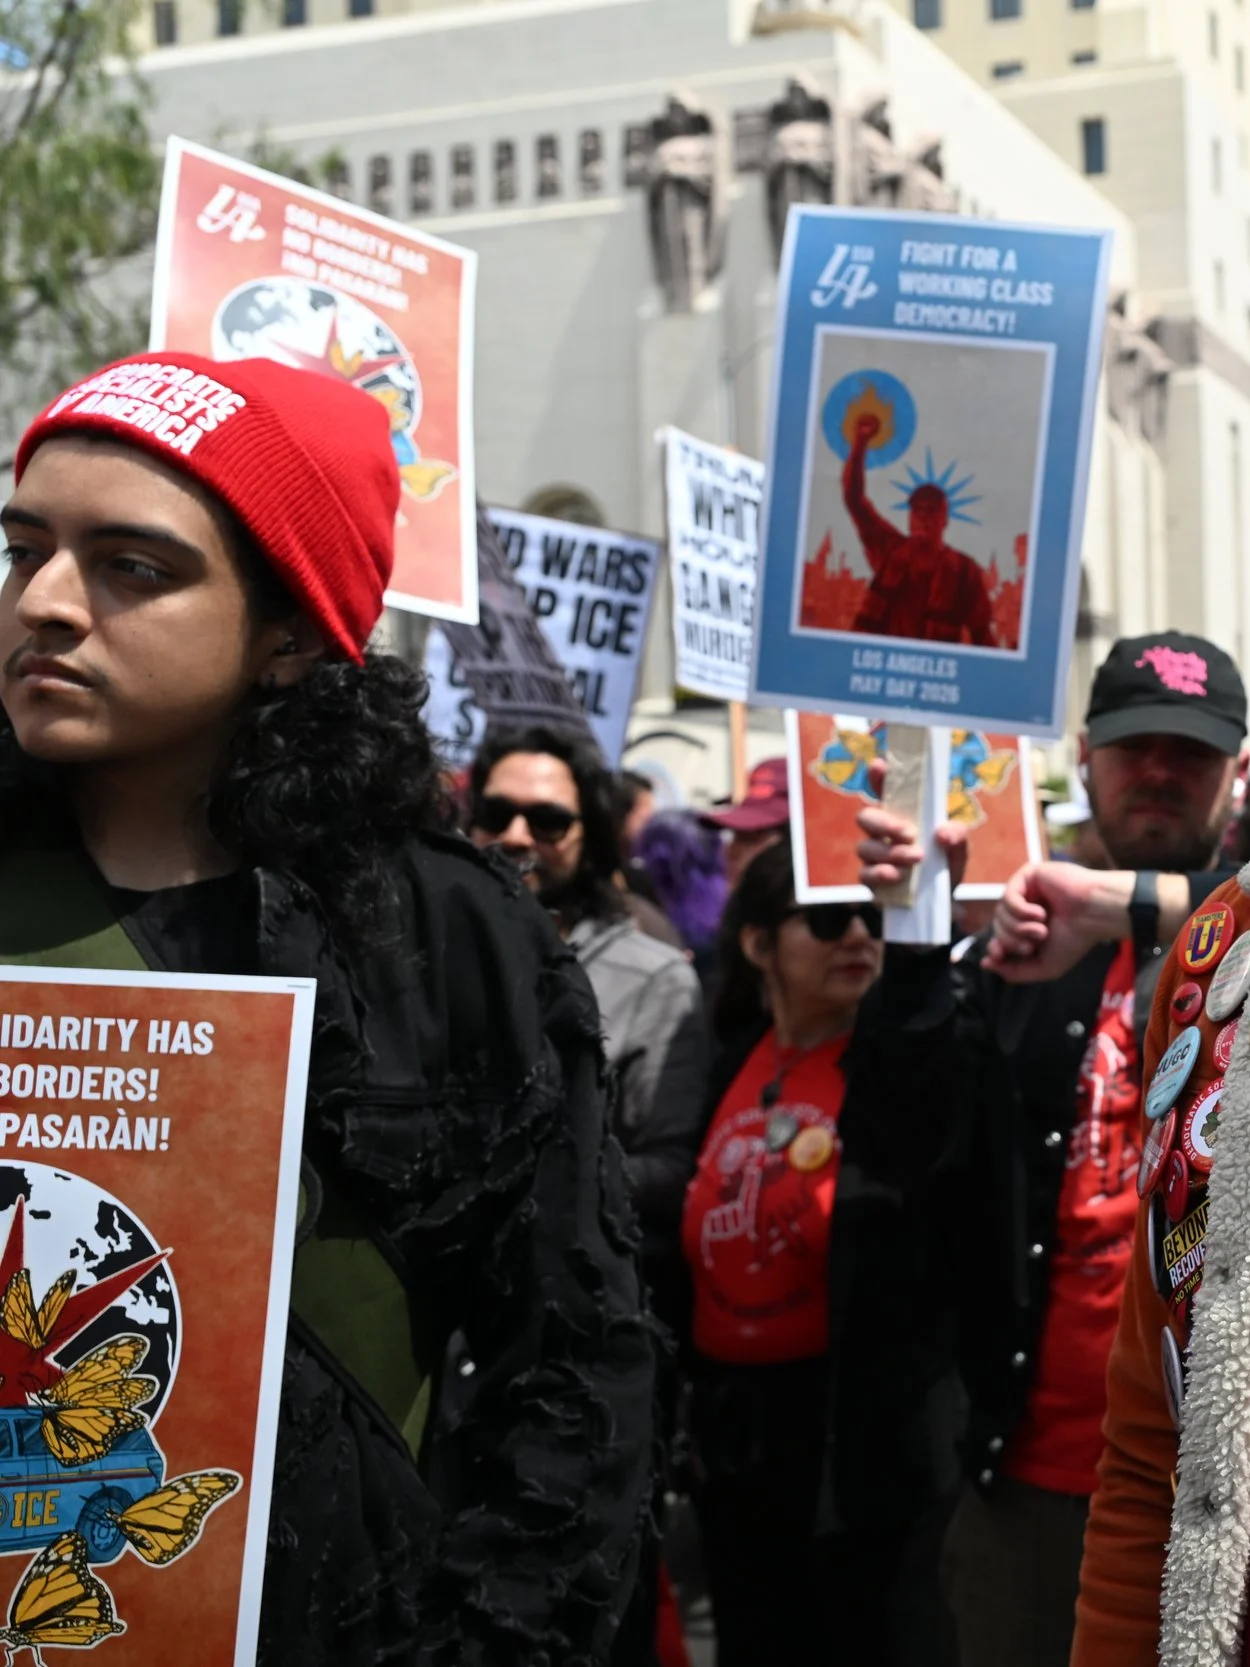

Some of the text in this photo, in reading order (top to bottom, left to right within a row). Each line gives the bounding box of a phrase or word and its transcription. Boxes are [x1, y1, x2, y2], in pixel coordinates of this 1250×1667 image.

[901, 240, 1018, 272] FIGHT FOR A
[898, 270, 1054, 306] WORKING CLASS
[894, 301, 1016, 334] DEMOCRACY!
[72, 392, 203, 455] AMERICA
[542, 532, 650, 595] WARS
[568, 595, 641, 657] ICE
[852, 648, 958, 679] LOS ANGELES
[849, 674, 960, 704] MAY DAY 2026
[0, 1013, 215, 1056] IDARITY HAS
[1156, 1043, 1191, 1076] HUGO
[0, 1063, 160, 1102] BORDERS!
[1184, 1094, 1206, 1161] DEMOCRATIC
[1175, 1276, 1200, 1304] NO TIME
[11, 1489, 60, 1528] ICE
